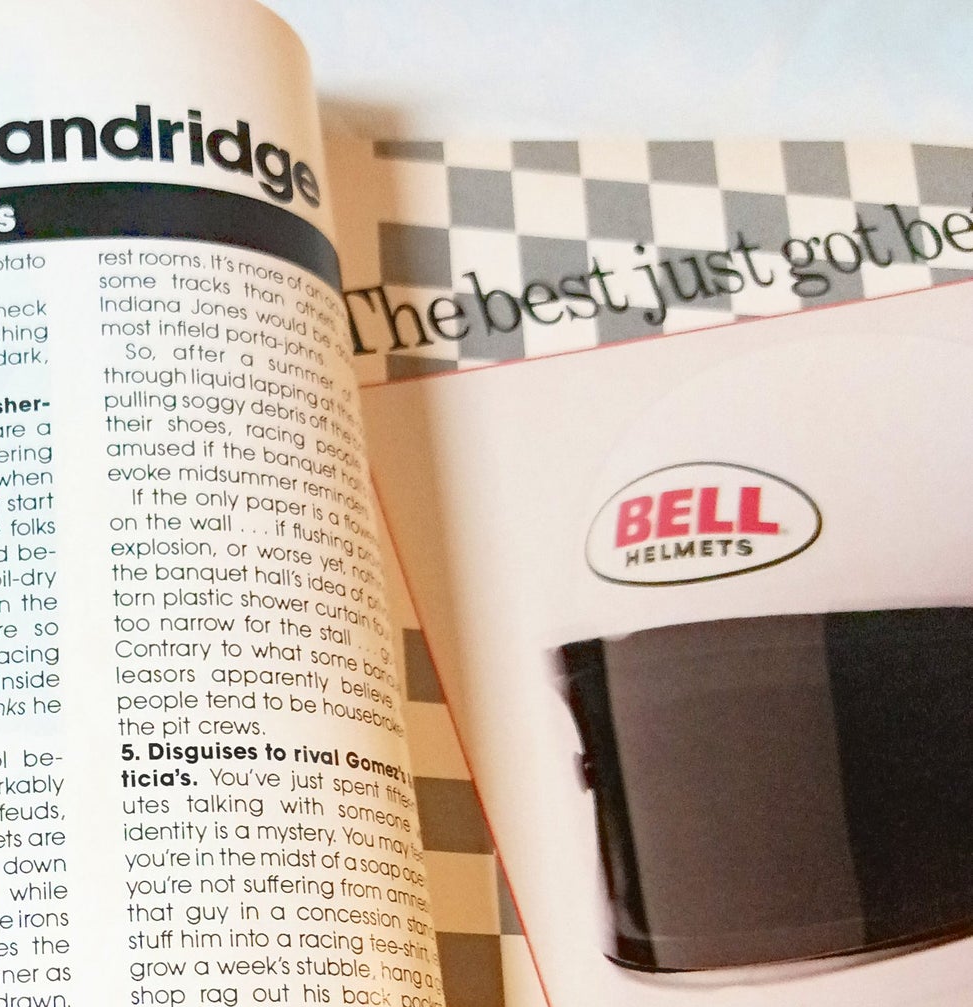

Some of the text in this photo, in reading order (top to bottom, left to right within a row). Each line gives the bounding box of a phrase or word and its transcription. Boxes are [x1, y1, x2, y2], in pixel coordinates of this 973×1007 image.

[343, 191, 973, 356] The best just got be
[37, 423, 51, 436] a
[614, 486, 780, 548] BELL
[18, 544, 56, 561] be-
[625, 538, 754, 568] HELMETS
[118, 717, 265, 739] the pit crews.
[23, 749, 63, 767] be-
[32, 936, 70, 955] the
